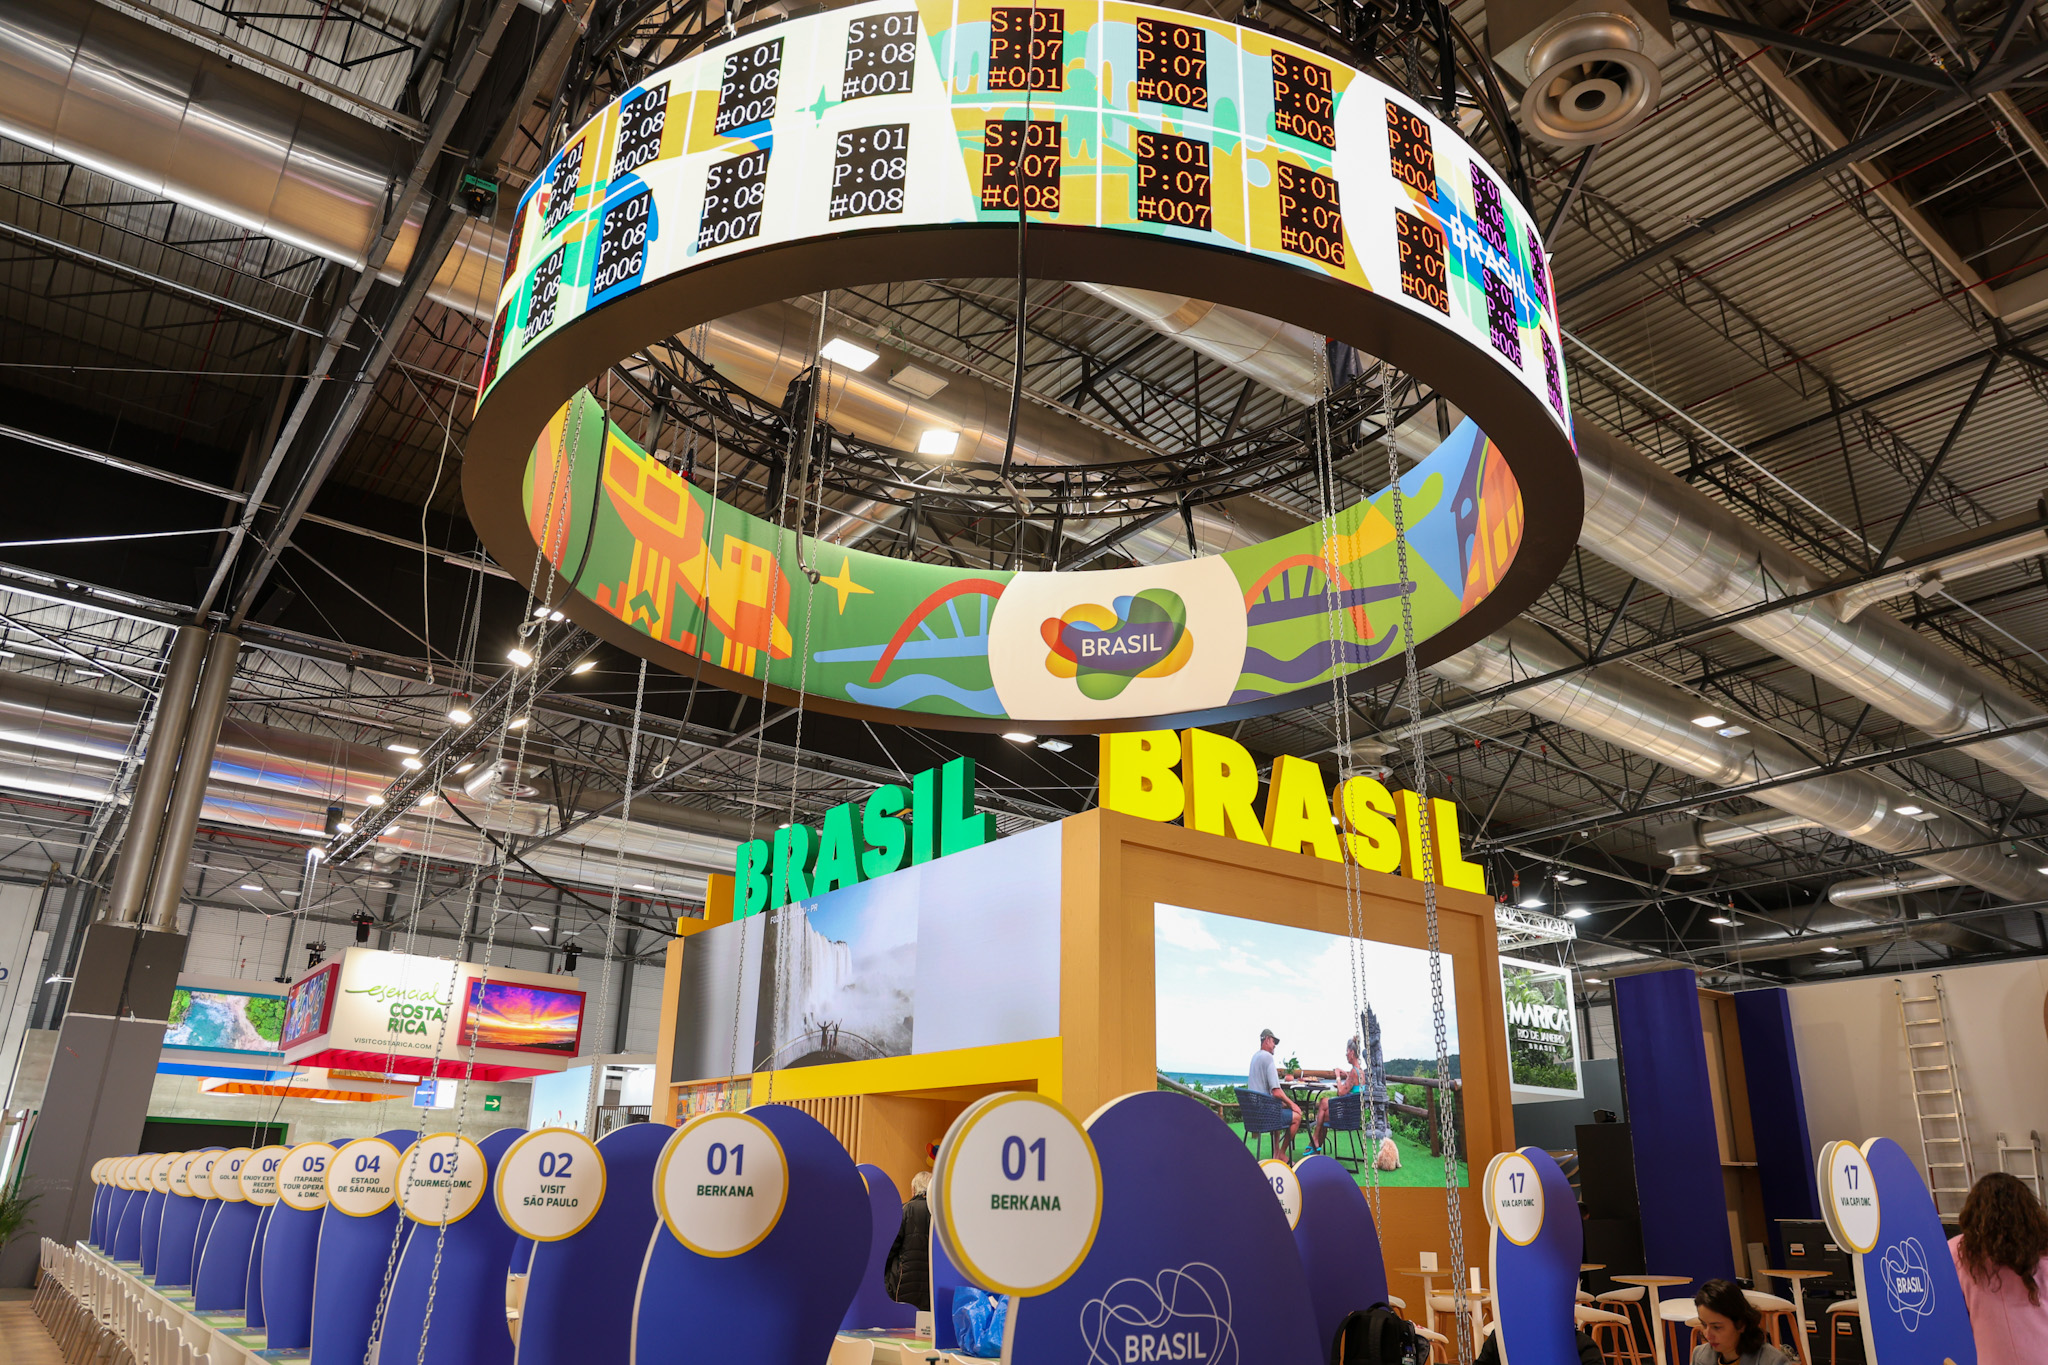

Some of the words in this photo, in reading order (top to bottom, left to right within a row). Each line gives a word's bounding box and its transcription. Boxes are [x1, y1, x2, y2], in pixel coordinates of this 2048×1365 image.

[848, 15, 916, 44] S:01
[991, 11, 1062, 33] S:01
[1137, 21, 1205, 54] S:01
[723, 41, 781, 79] S:01
[845, 42, 915, 71] P:08
[990, 38, 1063, 60] P:07
[1137, 48, 1207, 79] P:07
[719, 68, 780, 105] P:08
[842, 70, 911, 98] #001
[989, 66, 1061, 89] #001
[1271, 54, 1331, 93] S:01
[622, 86, 667, 127] S:01
[1137, 77, 1208, 109] #002
[1273, 80, 1333, 119] P:07
[715, 96, 776, 132] #002
[1275, 108, 1336, 148] #003
[1385, 102, 1431, 147] S:01
[617, 111, 665, 153] P:08
[836, 127, 907, 158] S:01
[985, 124, 1059, 148] S:01
[552, 142, 583, 184] S:01
[612, 138, 660, 179] #003
[984, 153, 1060, 178] P:07
[1137, 134, 1208, 168] S:01
[1388, 128, 1434, 171] P:07
[706, 153, 767, 190] S:01
[833, 157, 906, 187] P:08
[1138, 164, 1210, 197] P:07
[1278, 166, 1340, 205] S:01
[1391, 156, 1438, 201] #004
[1470, 163, 1502, 209] S:01
[547, 167, 580, 211] P:08
[701, 182, 765, 220] P:08
[830, 187, 904, 217] #008
[982, 184, 1059, 209] #008
[543, 193, 575, 239] #004
[602, 194, 649, 236] S:01
[1138, 195, 1211, 228] #007
[1279, 194, 1341, 234] P:07
[1473, 188, 1506, 233] P:05
[597, 222, 647, 265] P:08
[697, 211, 761, 248] #007
[1281, 225, 1345, 265] #006
[1396, 212, 1443, 256] S:01
[1477, 215, 1510, 263] #004
[532, 248, 564, 291] S:01
[593, 251, 642, 293] #006
[1399, 240, 1445, 282] P:07
[527, 274, 561, 318] P:08
[1401, 270, 1450, 313] #005
[1482, 268, 1516, 314] S:01
[522, 302, 557, 348] #005
[1486, 294, 1519, 340] P:05
[1490, 324, 1522, 369] #005
[1081, 633, 1162, 657] BRASIL
[1099, 727, 1486, 895] BRASIL
[733, 756, 996, 922] BRASIL
[345, 982, 453, 1005] esencial
[387, 1017, 427, 1036] RICA
[390, 1003, 444, 1022] COSTA
[354, 1037, 432, 1050] VISITCOSTARICA.COM
[1517, 1028, 1529, 1039] RIO
[1530, 1030, 1539, 1040] DE
[1540, 1031, 1565, 1044] JANEIRO
[1528, 1042, 1557, 1052] BRASIL
[302, 1156, 325, 1173] 05
[354, 1154, 380, 1173] 04
[429, 1152, 458, 1174] 03
[538, 1151, 573, 1178] 02
[707, 1142, 744, 1176] 01
[1002, 1135, 1046, 1181] 01
[349, 1184, 364, 1193] SÃO
[350, 1177, 380, 1185] ESTADO
[411, 1179, 450, 1188] OURMED
[452, 1180, 472, 1188] DMC
[540, 1184, 566, 1194] VISIT
[696, 1184, 754, 1197] BERKANA
[1509, 1172, 1525, 1194] 17
[1844, 1164, 1858, 1190] 17
[523, 1195, 544, 1207] SÃO
[546, 1198, 578, 1208] PAULO
[991, 1194, 1061, 1211] BERKANA
[1501, 1199, 1511, 1207] VIA
[1511, 1199, 1523, 1207] CAPI
[1524, 1198, 1535, 1207] DMC
[1840, 1197, 1850, 1206] VIA
[1850, 1197, 1860, 1206] CAPI
[1860, 1197, 1872, 1206] DMC
[1896, 1276, 1924, 1294] BRASIL
[1125, 1332, 1207, 1364] BRASIL
